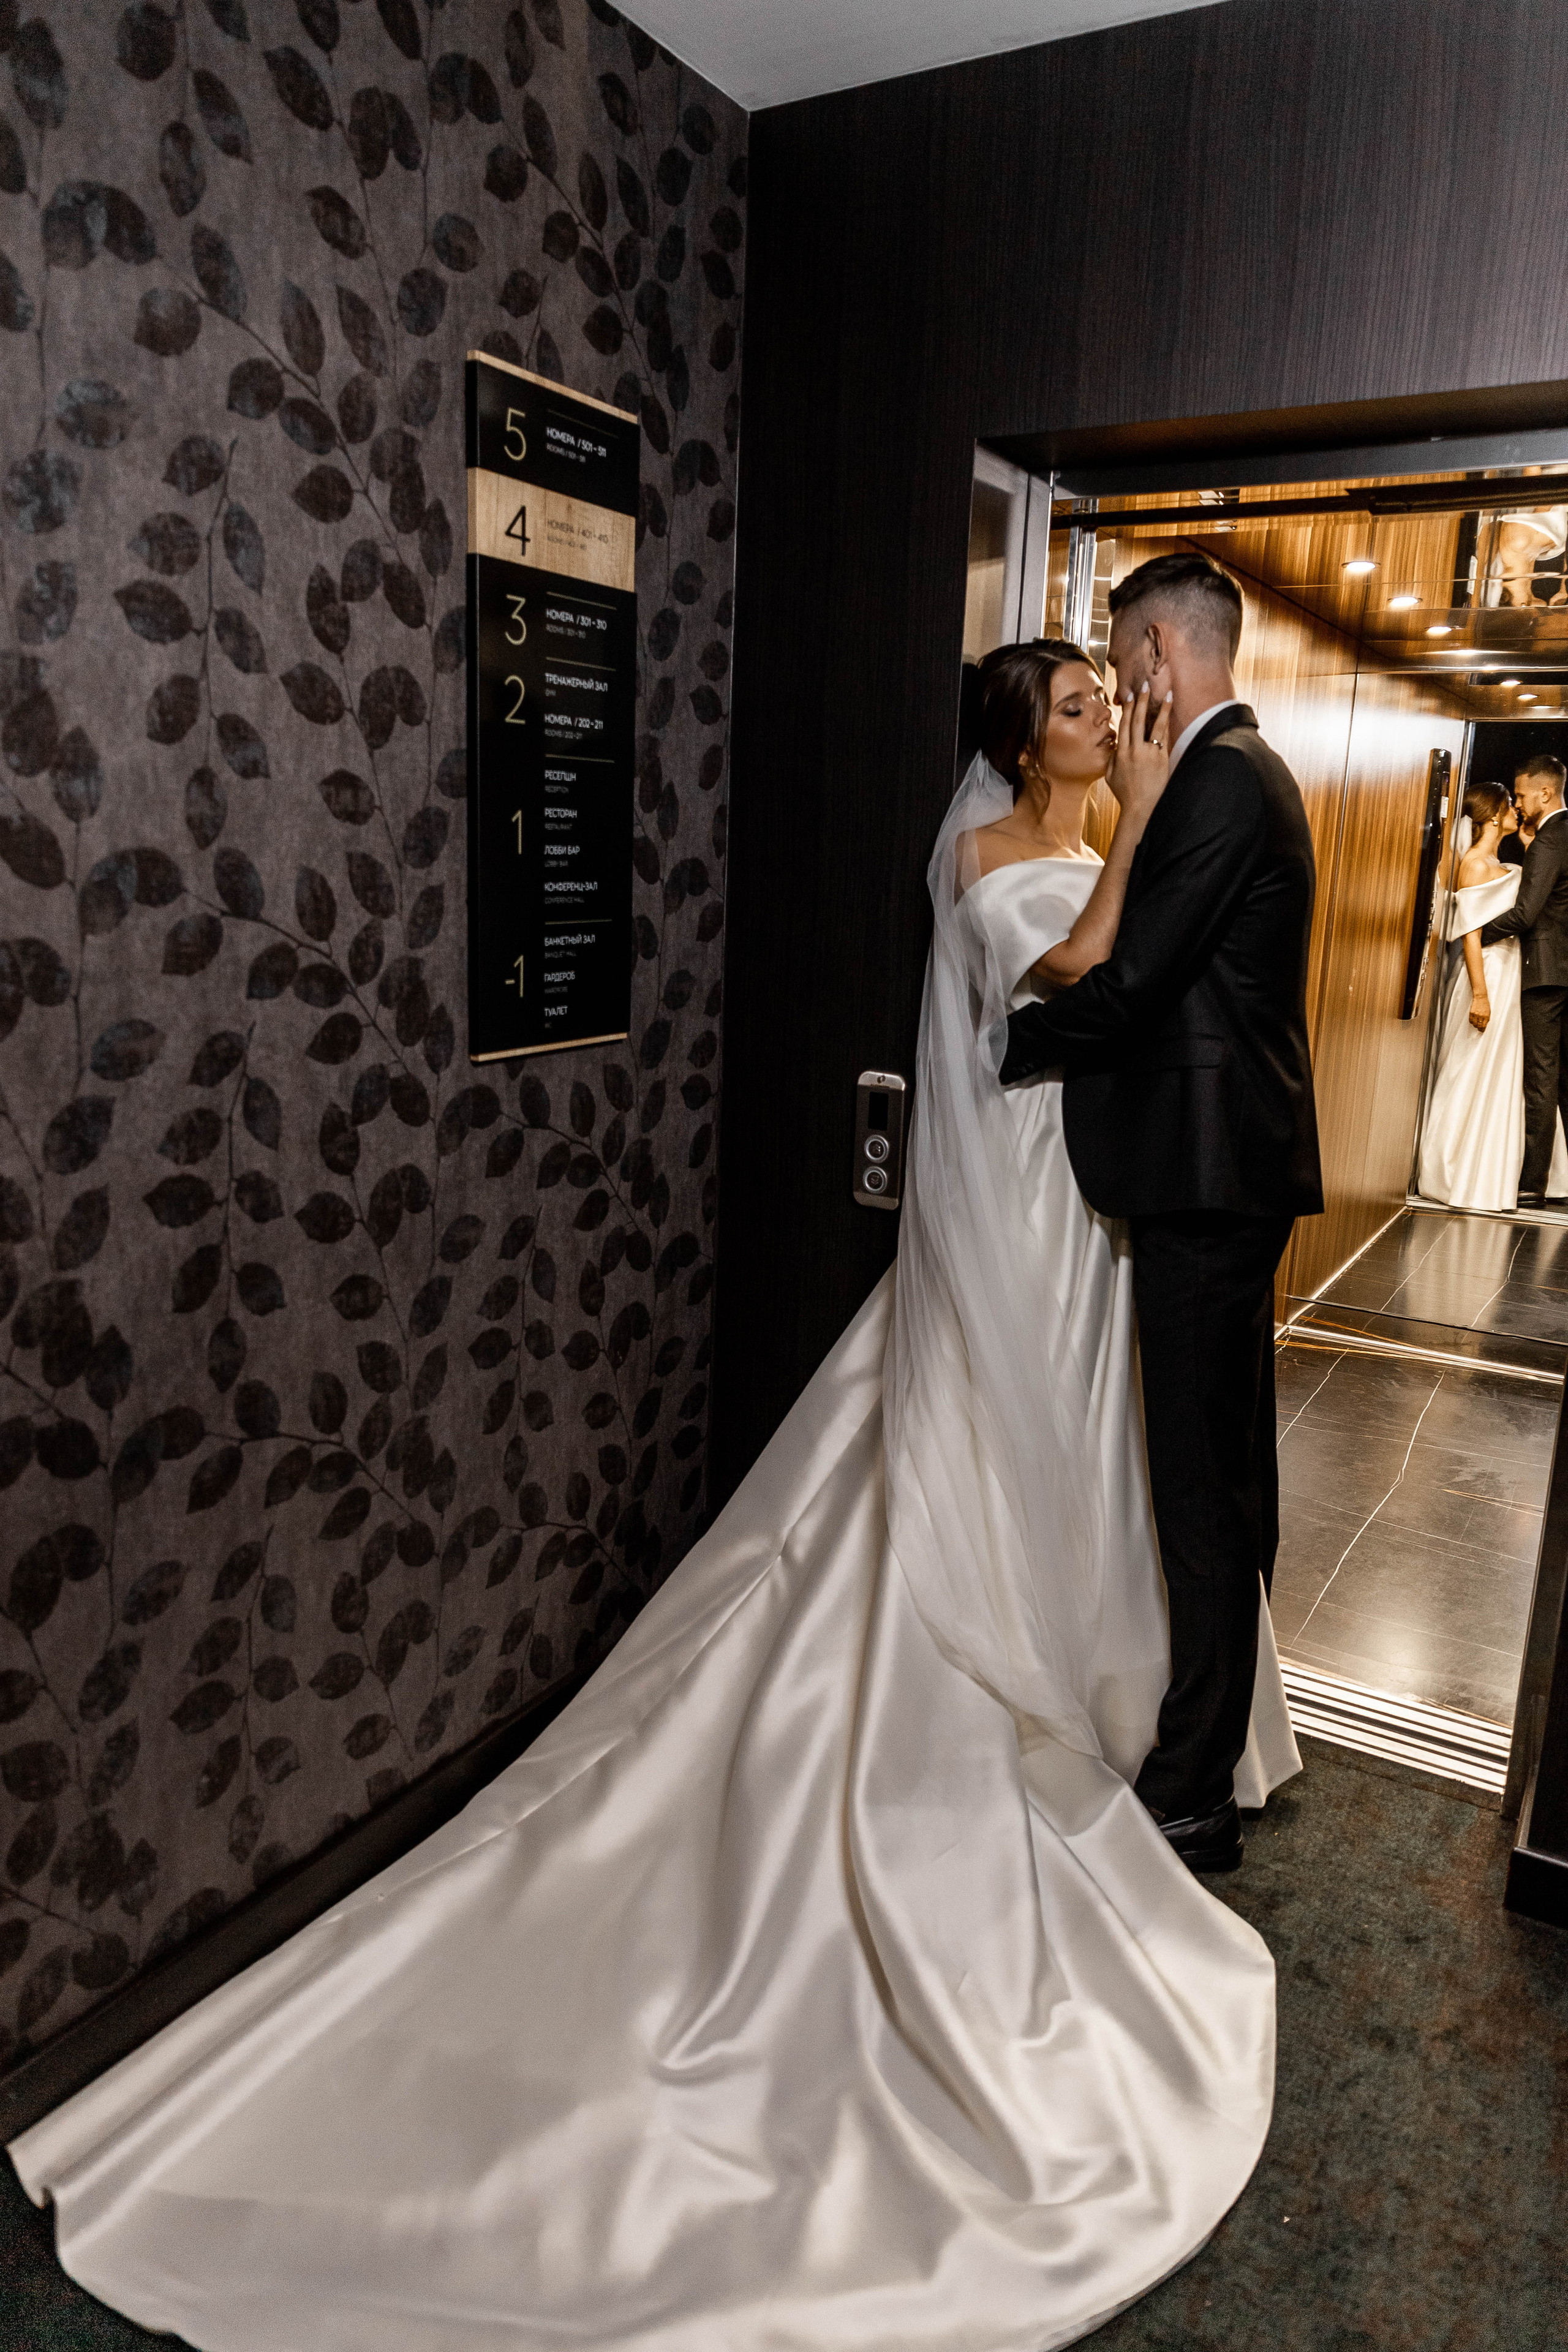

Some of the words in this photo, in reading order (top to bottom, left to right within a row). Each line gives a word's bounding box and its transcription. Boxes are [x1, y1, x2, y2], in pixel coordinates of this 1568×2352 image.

[504, 407, 527, 461] 5
[546, 427, 576, 446] НОМЕРА
[505, 505, 530, 556] 4
[505, 594, 526, 645] 3
[546, 608, 575, 624] НОМЕРА
[595, 680, 608, 692] ЗАЛ
[505, 675, 526, 725] 2
[545, 714, 573, 726] НОМЕРА
[545, 807, 578, 818] РЕСТОРАН
[511, 809, 522, 855] 1
[544, 845, 567, 855] ЛОББИ
[567, 845, 581, 855] БАР
[545, 881, 598, 892] КОНФЕРЕНЦ-ЗАЛ
[545, 933, 582, 947] БАНКЕТНЫЙ
[582, 933, 596, 944] ЗАЛ
[505, 954, 524, 998] -1
[544, 971, 576, 982] ГАРДЕРОБ
[544, 1005, 568, 1017] ТУАЛЕТ
